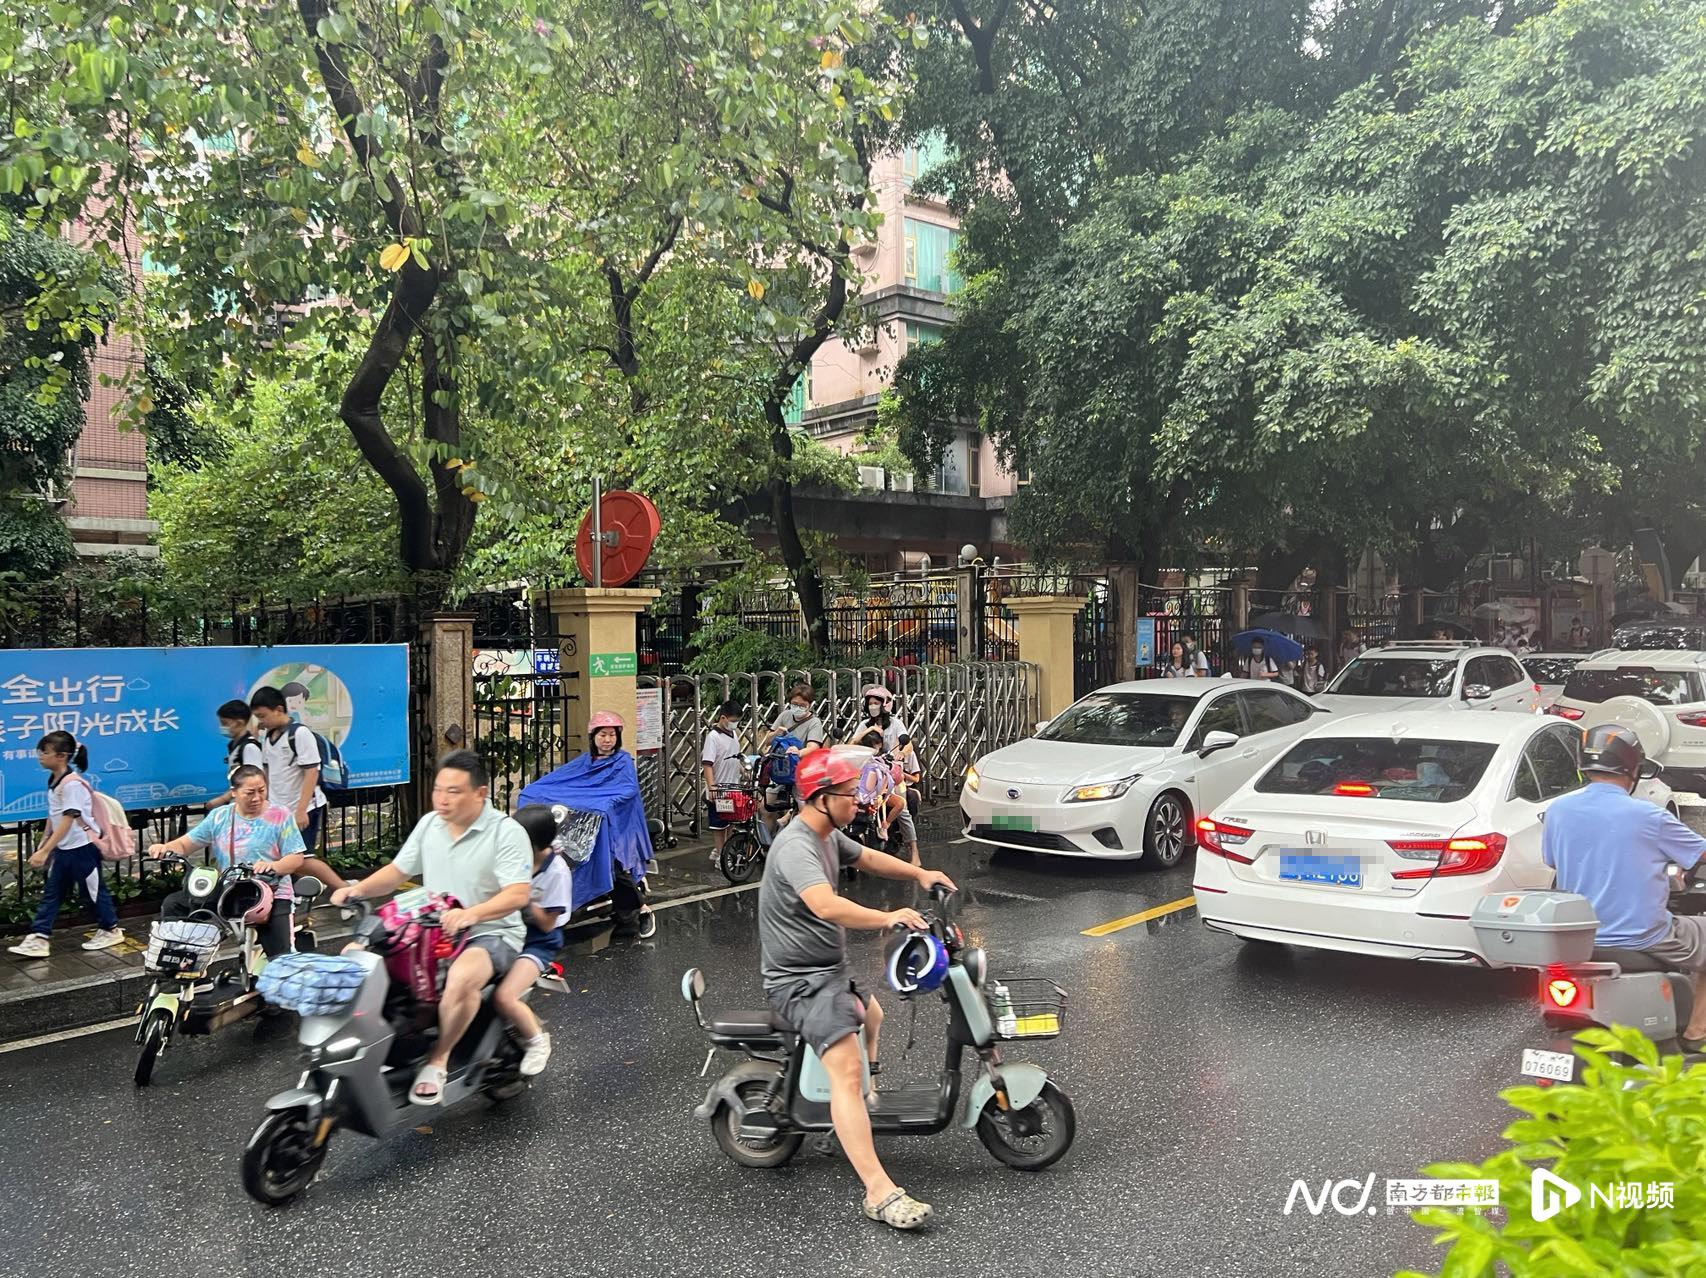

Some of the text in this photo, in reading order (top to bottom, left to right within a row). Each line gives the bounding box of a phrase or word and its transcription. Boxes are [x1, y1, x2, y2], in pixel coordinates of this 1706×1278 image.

[1, 673, 126, 707] 全出行
[0, 708, 179, 743] 子阳光成长
[1524, 1060, 1570, 1077] 076069
